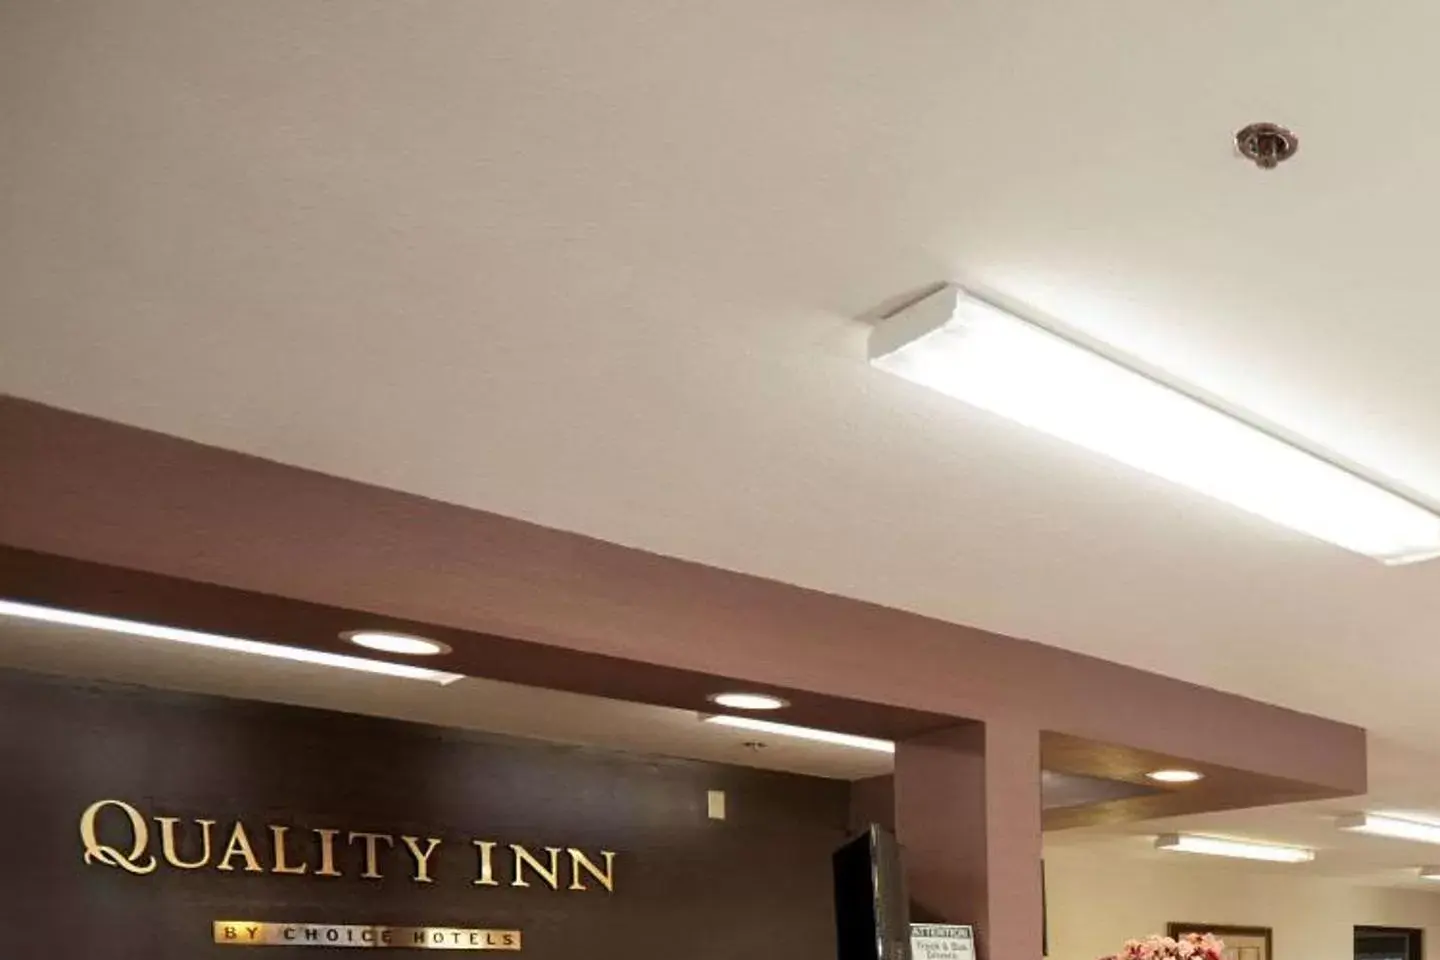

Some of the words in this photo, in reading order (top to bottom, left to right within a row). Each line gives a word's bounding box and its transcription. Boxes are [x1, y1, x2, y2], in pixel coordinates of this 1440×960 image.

[80, 799, 443, 884] QUALITY
[473, 839, 617, 893] INN
[223, 926, 260, 941] BY
[283, 927, 393, 945] CHOICE
[413, 931, 515, 947] HOTELS
